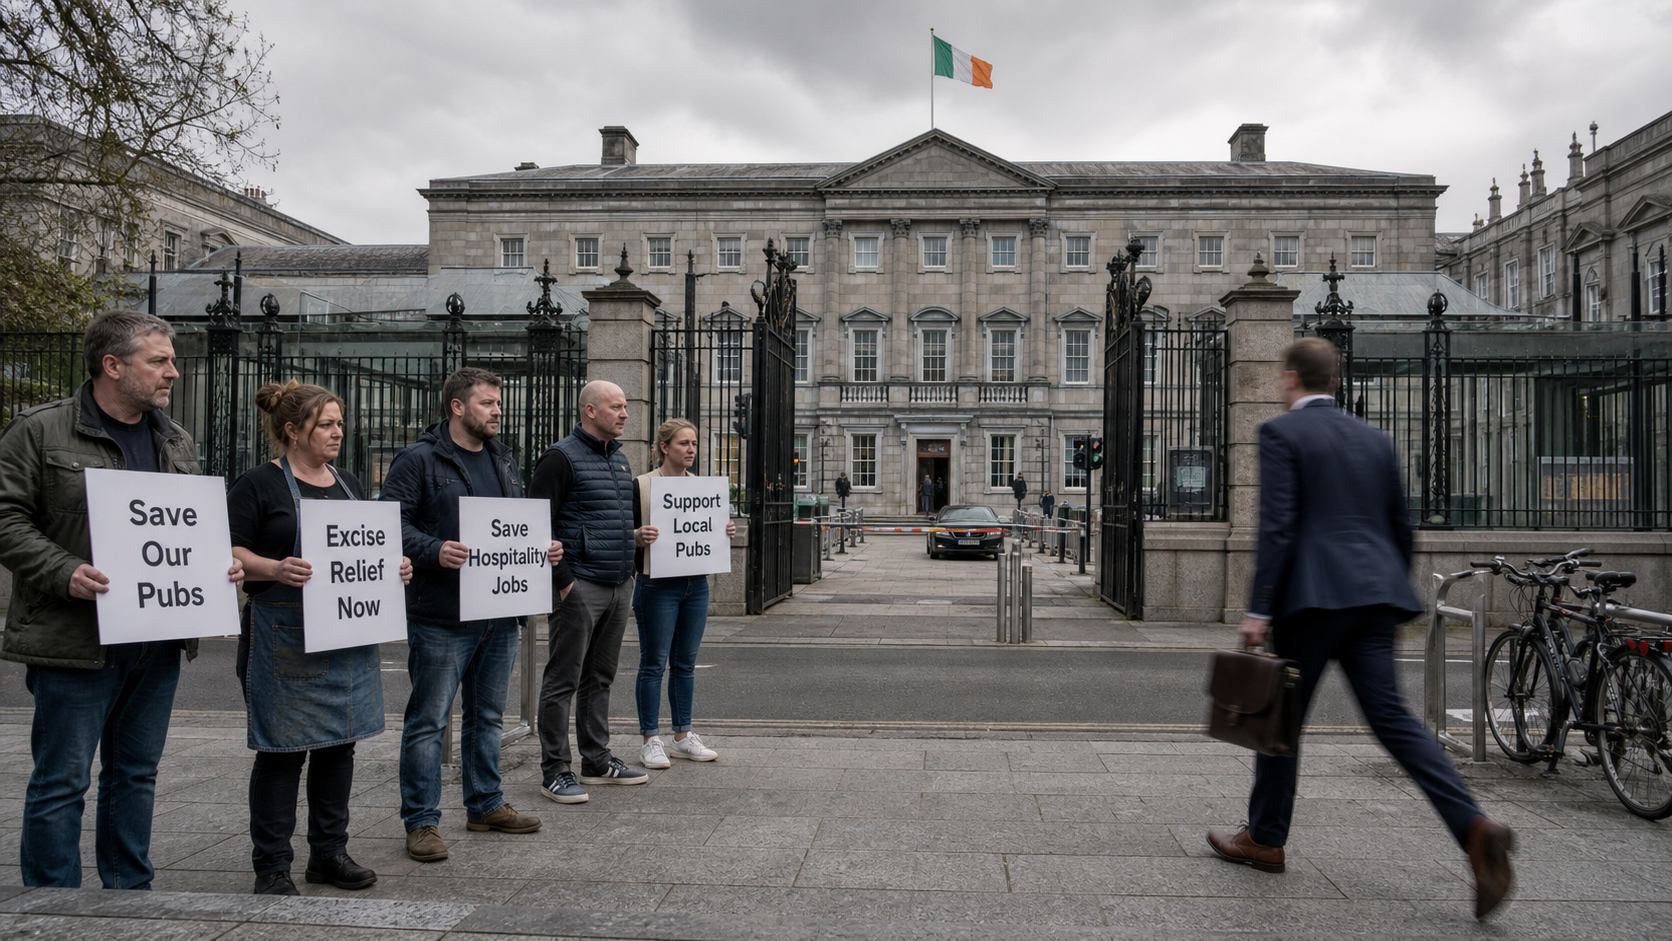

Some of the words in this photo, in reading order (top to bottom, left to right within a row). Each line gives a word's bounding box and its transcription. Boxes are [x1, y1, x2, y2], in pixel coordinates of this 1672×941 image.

[128, 498, 198, 527] Save
[662, 492, 722, 513] Support
[326, 523, 386, 548] Excise
[490, 518, 529, 538] Save
[673, 516, 713, 534] Local
[141, 540, 193, 568] Our
[468, 546, 548, 570] Hospitality
[675, 540, 711, 558] Pubs
[330, 557, 385, 584] Relief
[137, 580, 205, 609] Pubs
[491, 575, 529, 595] Jobs
[337, 595, 381, 620] Now
